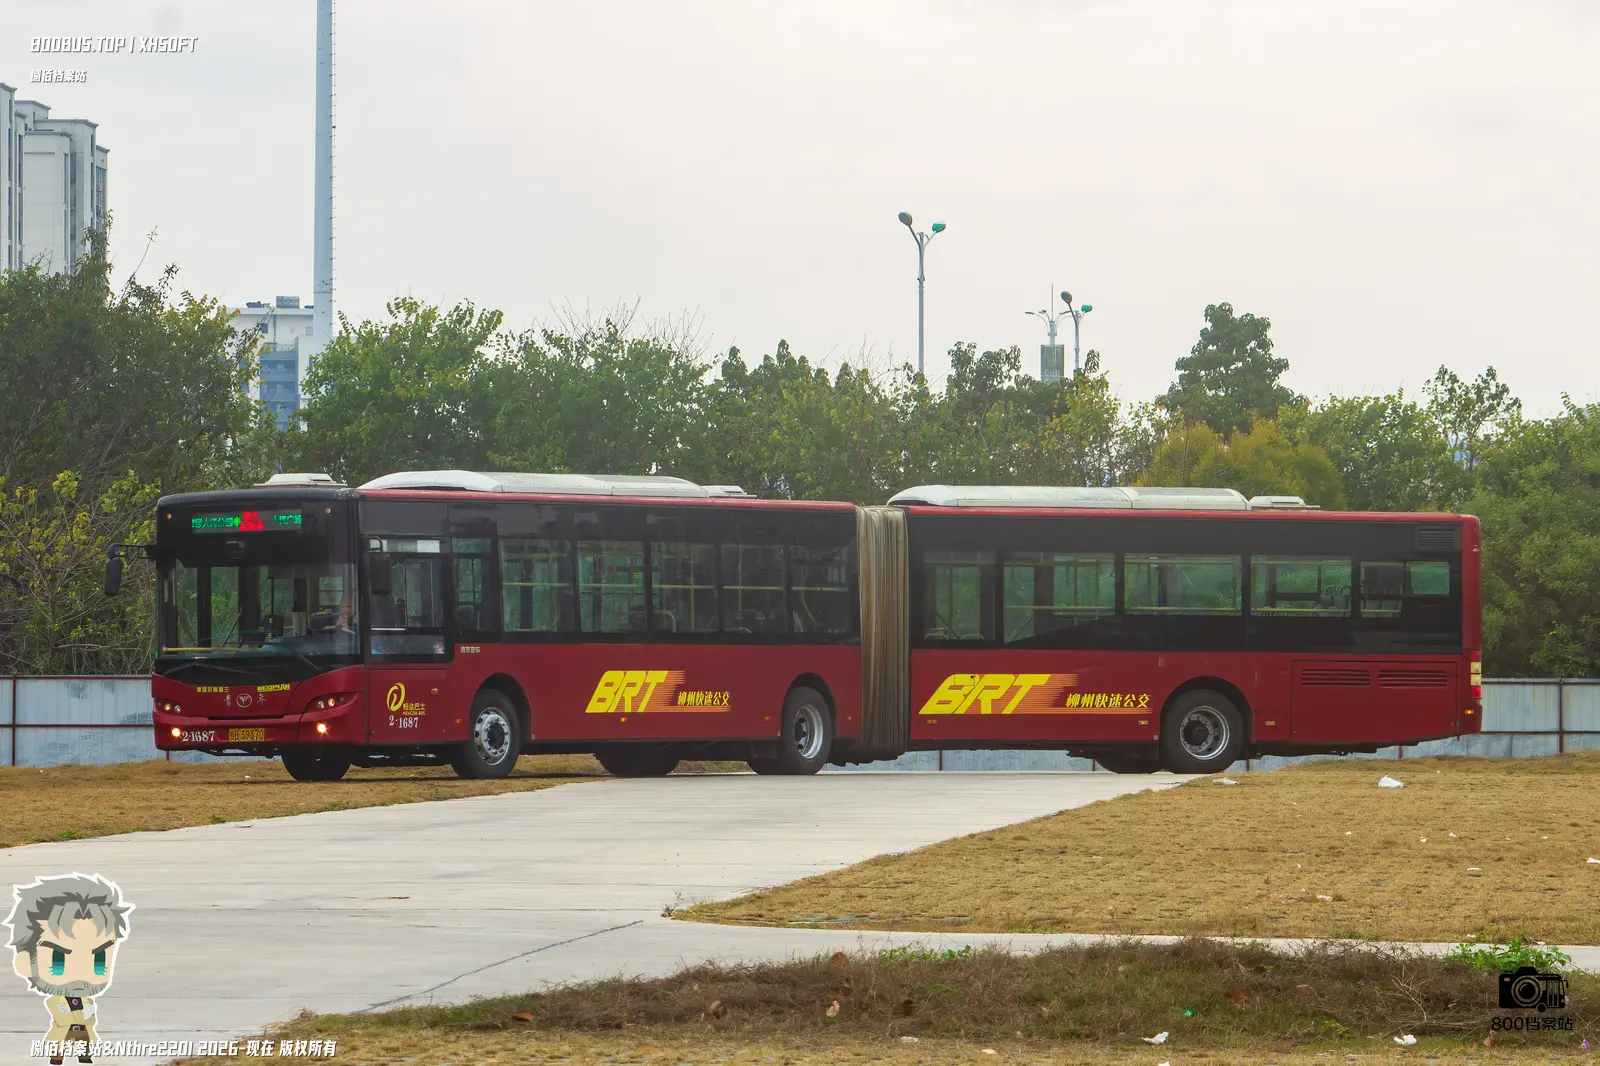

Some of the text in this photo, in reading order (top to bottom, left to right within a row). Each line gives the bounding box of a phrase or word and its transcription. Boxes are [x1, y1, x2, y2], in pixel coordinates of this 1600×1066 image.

[257, 684, 290, 692] NEOPLAN
[585, 670, 668, 713] BRT
[919, 673, 1051, 715] BRT
[677, 691, 731, 706] 柳州快速公交
[1065, 693, 1151, 708] 柳州快速公交
